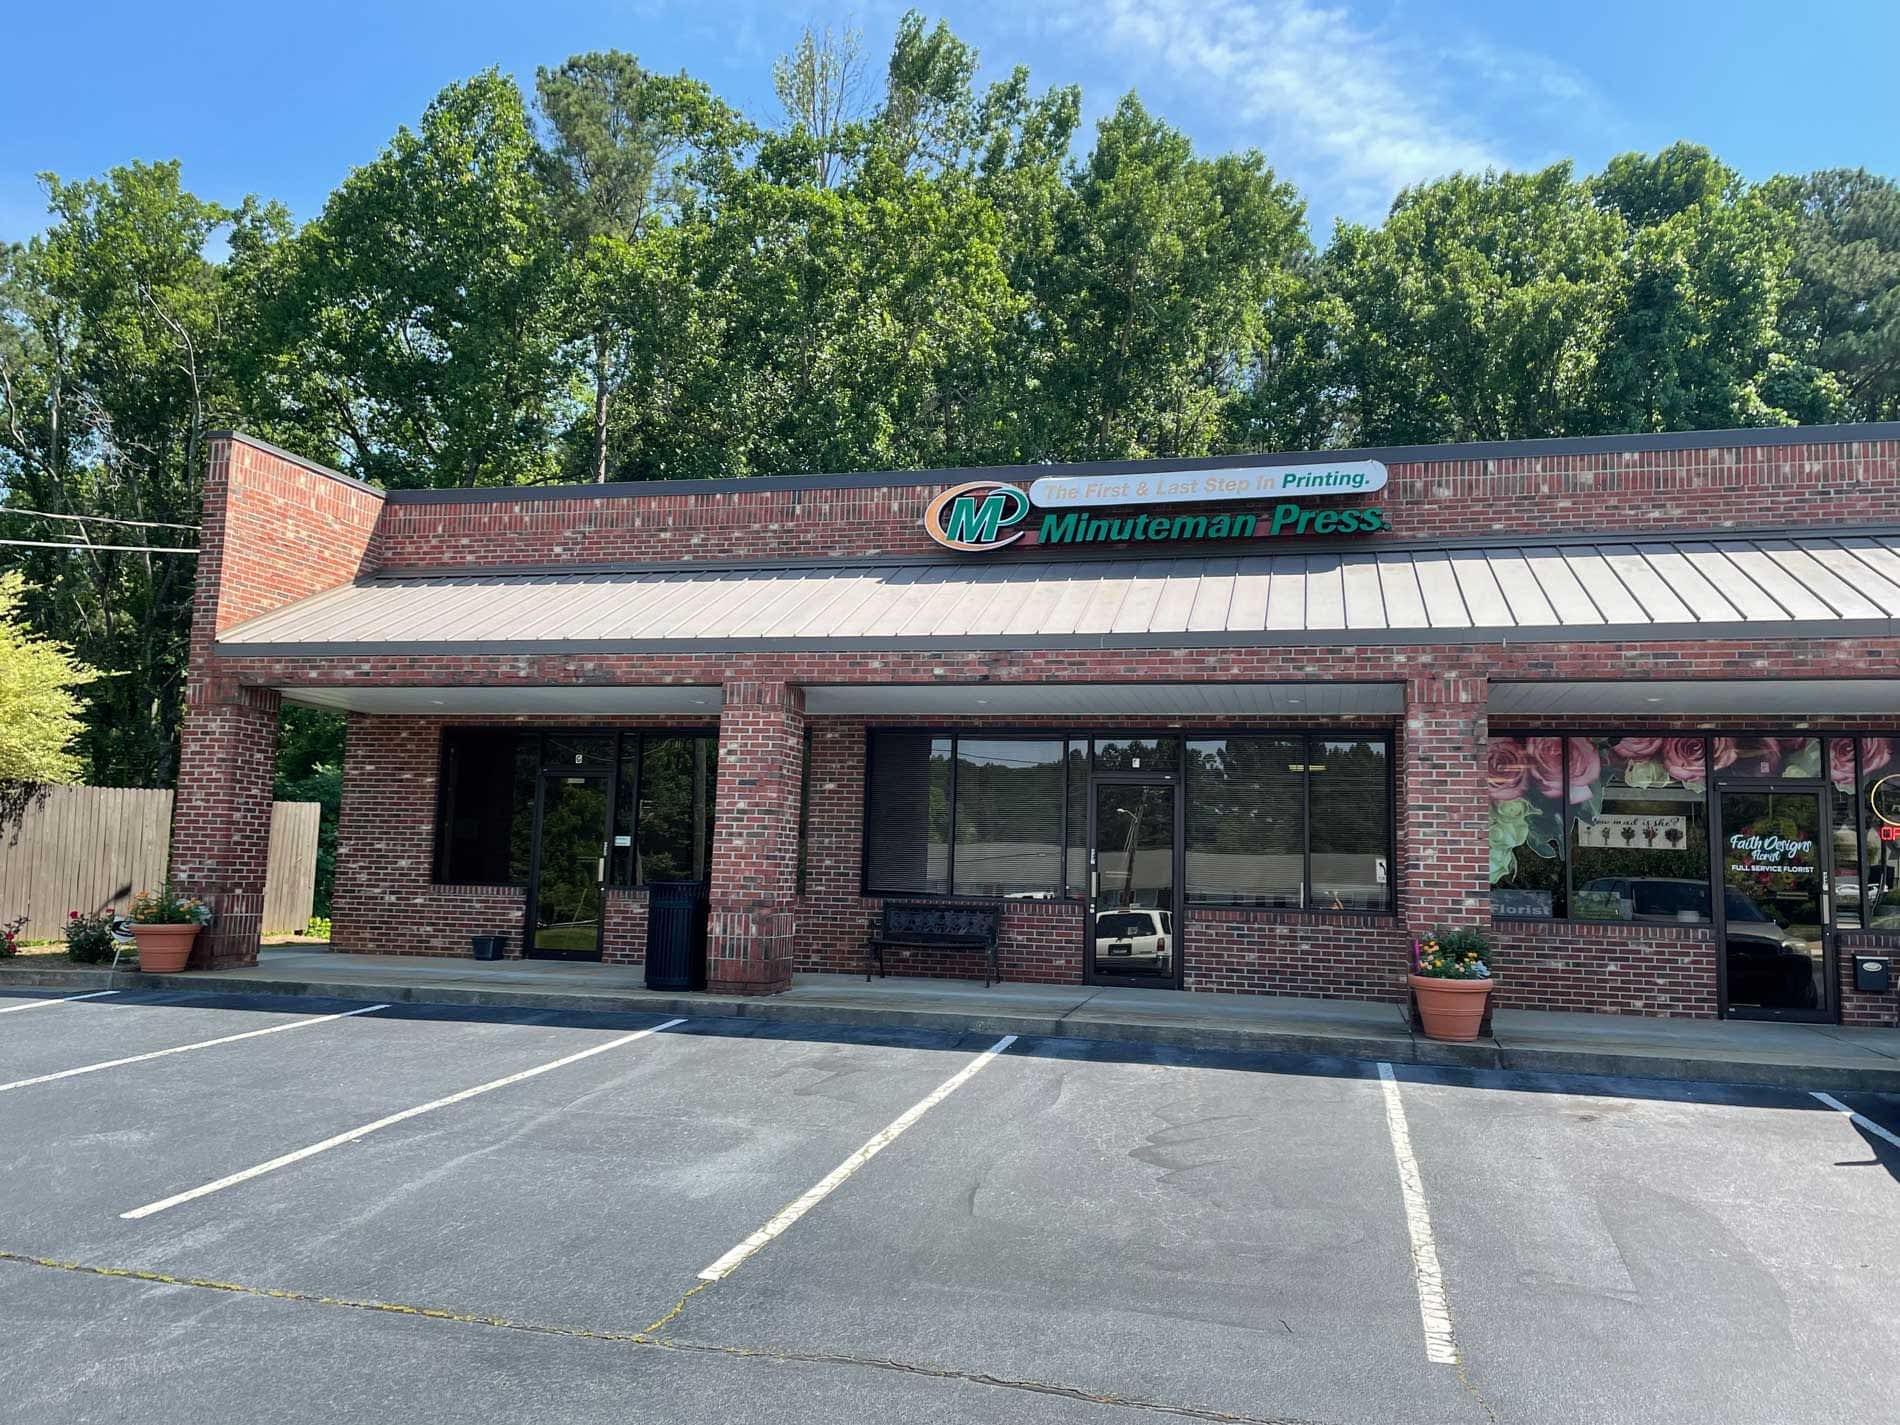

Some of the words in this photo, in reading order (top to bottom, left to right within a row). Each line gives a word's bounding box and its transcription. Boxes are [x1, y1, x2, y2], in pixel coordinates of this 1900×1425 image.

[1044, 484, 1079, 500] The
[1085, 482, 1130, 498] First
[1135, 480, 1148, 496] &
[1156, 479, 1198, 496] Last
[1203, 477, 1249, 495] Step
[1282, 471, 1370, 488] Printing.
[1038, 512, 1257, 543] Minuteman
[1730, 834, 1761, 849] Faith
[1763, 835, 1812, 858] Designs
[1731, 864, 1751, 872] FULL
[1751, 864, 1782, 873] SERVICE
[1783, 865, 1815, 873] FLORIST
